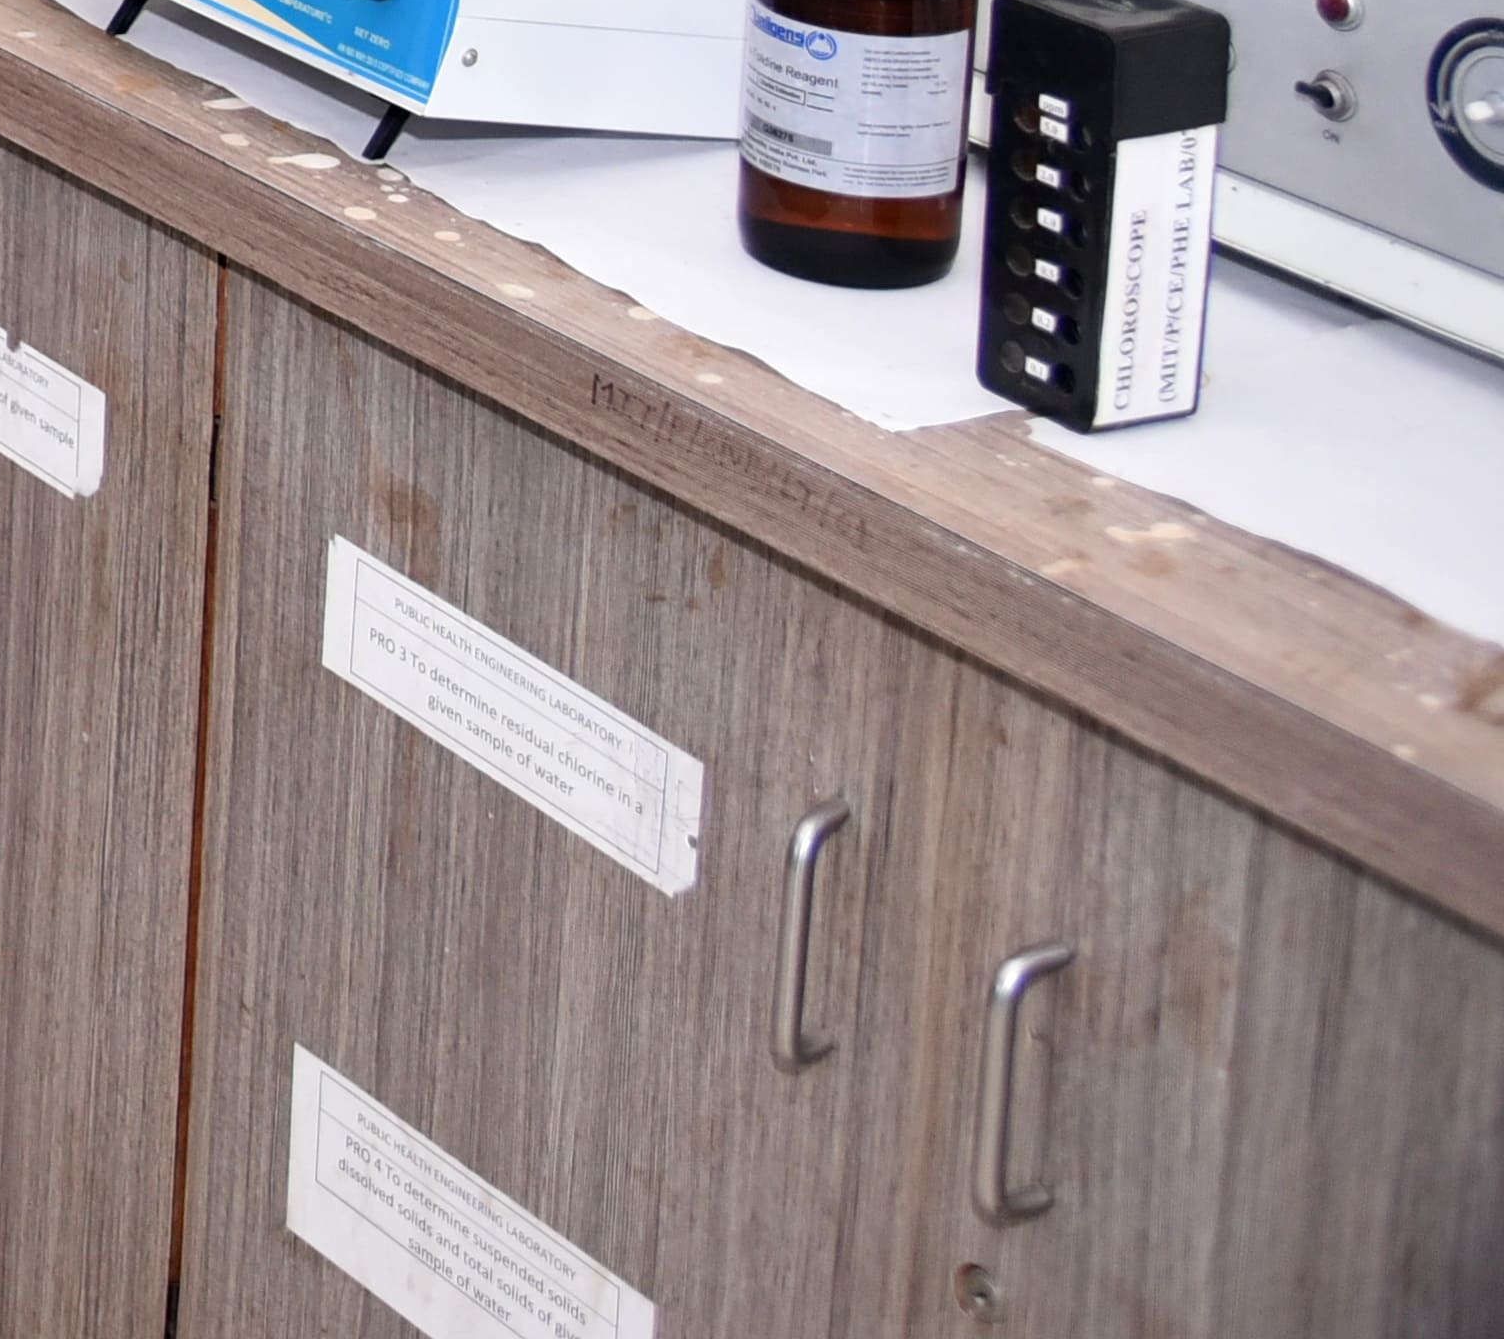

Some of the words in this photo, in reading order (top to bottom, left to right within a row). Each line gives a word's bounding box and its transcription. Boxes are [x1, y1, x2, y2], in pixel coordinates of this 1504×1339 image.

[354, 25, 368, 40] SET
[369, 32, 391, 50] ZERO
[1176, 128, 1199, 209] LAB/0
[1322, 130, 1341, 145] ON
[369, 627, 396, 655] PRO
[399, 645, 407, 662] 3
[410, 651, 427, 675] To
[429, 666, 498, 721] determine
[500, 714, 554, 758] residual
[557, 750, 615, 796] chlorine
[618, 786, 631, 808] in
[634, 803, 645, 817] a
[394, 597, 431, 630] PUBLIC
[432, 620, 472, 655] HEALTH
[474, 647, 547, 703] ENGINEERING
[548, 694, 623, 750] LABORATORY
[427, 694, 463, 726] given
[465, 719, 513, 759] sample
[516, 752, 533, 769] of
[534, 762, 575, 796] water
[338, 1158, 394, 1209] dissolved
[397, 1203, 433, 1238] solids
[435, 1232, 460, 1258] and
[463, 1250, 493, 1284] total
[496, 1278, 534, 1314] solids
[537, 1309, 552, 1327] of
[345, 1135, 371, 1166] PRO
[373, 1158, 382, 1172] 4
[385, 1163, 401, 1187] To
[403, 1181, 470, 1239] determine
[472, 1233, 544, 1295] suspended
[547, 1288, 586, 1326] solids
